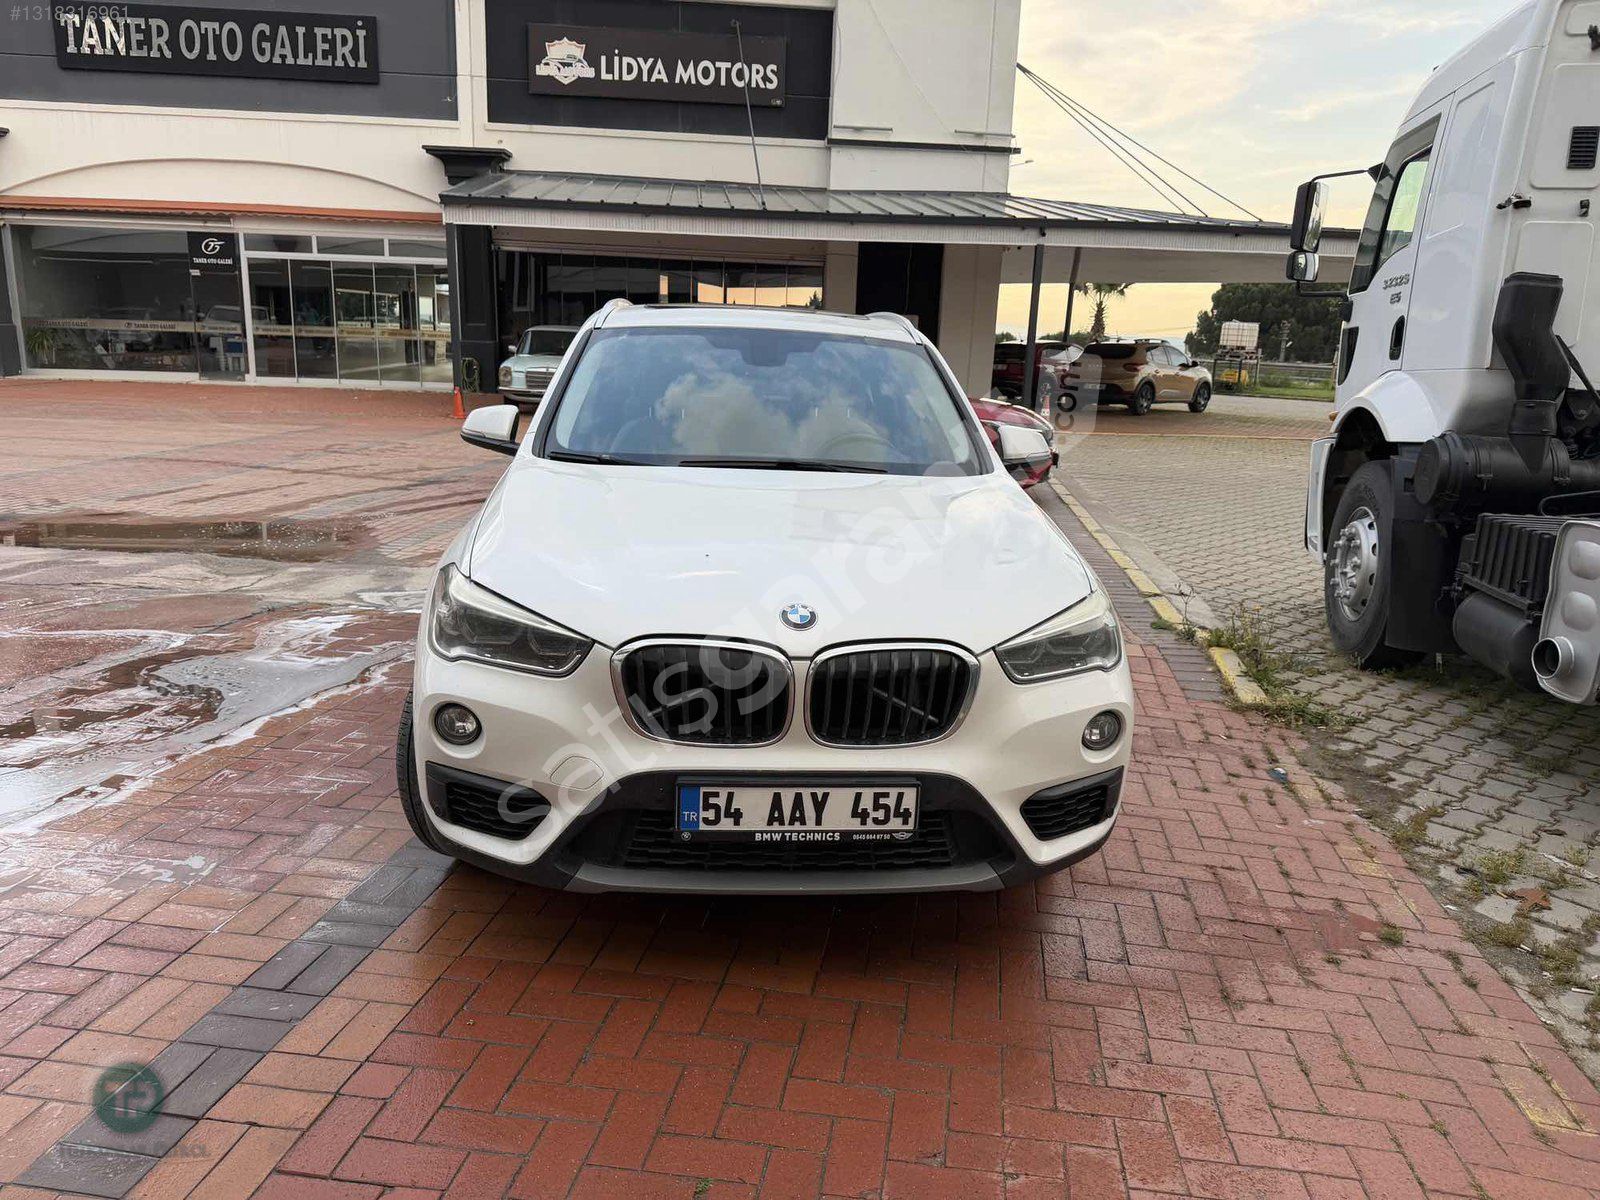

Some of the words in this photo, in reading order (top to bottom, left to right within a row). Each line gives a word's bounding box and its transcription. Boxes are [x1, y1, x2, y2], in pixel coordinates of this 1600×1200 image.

[60, 13, 172, 59] TANER
[179, 19, 243, 62] OTO
[251, 20, 368, 68] GALERİ
[600, 48, 669, 83] LİDYA
[675, 59, 779, 90] MOTORS
[682, 811, 698, 823] TR
[702, 791, 743, 827] 54
[766, 791, 830, 827] AAY
[850, 791, 912, 827] 454
[755, 832, 782, 841] BMW
[785, 832, 841, 842] TECHNICS
